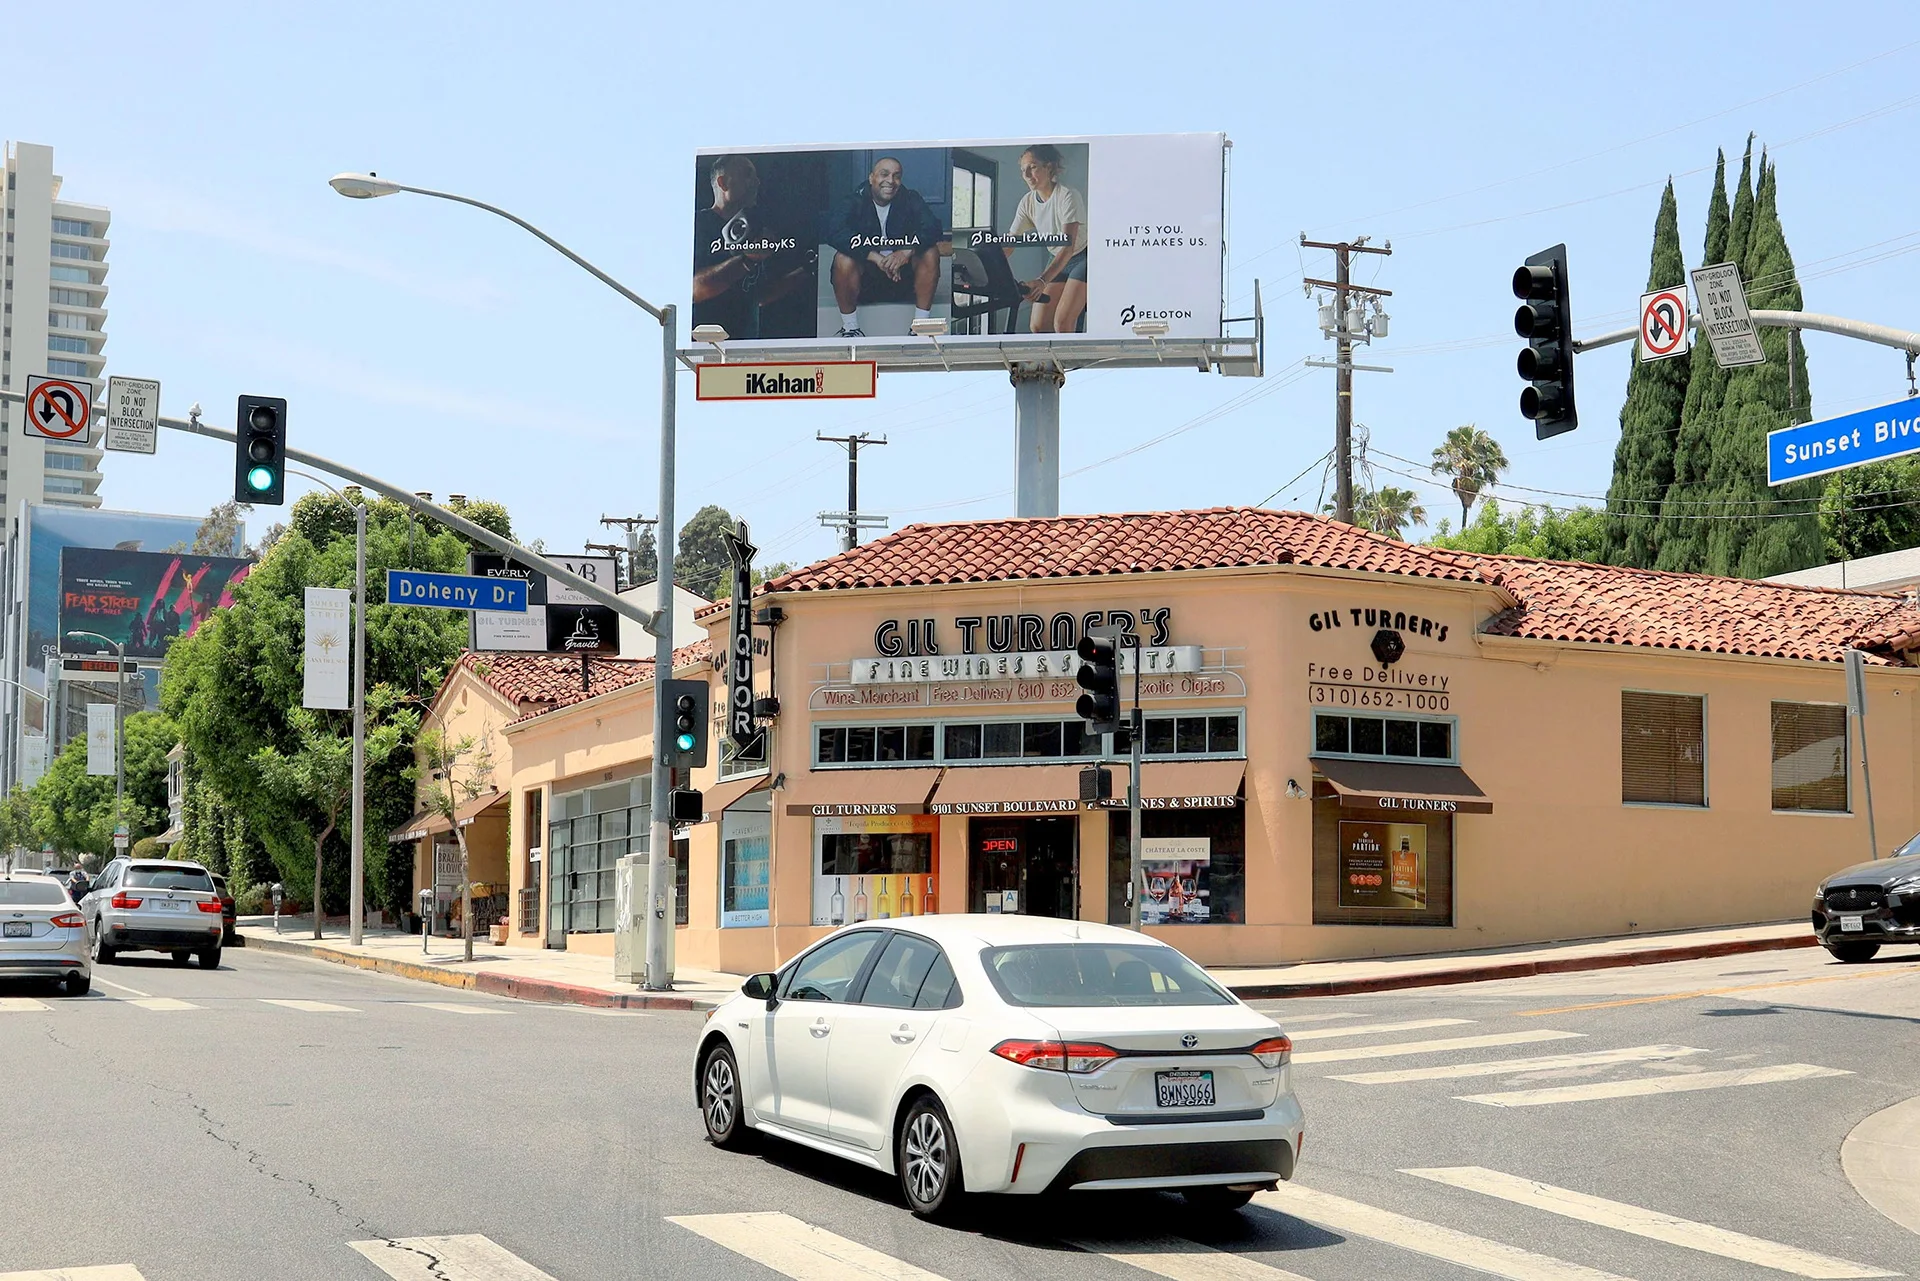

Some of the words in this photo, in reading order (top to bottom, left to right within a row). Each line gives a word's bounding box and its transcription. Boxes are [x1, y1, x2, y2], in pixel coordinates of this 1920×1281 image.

[1129, 225, 1151, 235] IT'S
[1156, 225, 1184, 235] YOU.
[862, 235, 920, 247] ACfromLA
[984, 231, 1069, 244] Berlin_It2WinIt
[1105, 238, 1136, 247] THAT
[1141, 237, 1184, 247] MAKES
[1189, 237, 1208, 247] US.
[724, 238, 796, 252] LondonBoyKS
[1694, 268, 1735, 283] ANTI-GRIDLOCK
[1709, 279, 1724, 289] ZONE
[1707, 292, 1718, 305] DO
[1719, 289, 1732, 303] NOT
[1138, 310, 1192, 320] PELOTON
[1713, 305, 1735, 320] BLOCK
[1708, 319, 1752, 336] INTERSECTION
[112, 380, 157, 391] ANTI-GRIDLOCK
[120, 395, 131, 405] DO
[134, 397, 146, 407] NOT
[122, 407, 143, 418] BLOCK
[110, 417, 154, 430] INTERSECTION
[1785, 427, 1861, 464] Sunset
[487, 569, 531, 578] EVERLY
[400, 579, 478, 606] Doheny
[493, 586, 516, 604] Dr
[65, 592, 96, 609] FEAR
[100, 596, 141, 610] STREET
[310, 600, 345, 608] SUNSET
[310, 611, 345, 619] STRIP
[1309, 609, 1342, 632] GIL
[1350, 608, 1449, 642] TURNER'S
[874, 618, 939, 657] GIL
[955, 607, 1171, 655] TURNER'S
[736, 582, 752, 734] LIQUOR
[81, 661, 118, 672] NETFLIX
[870, 659, 929, 679] FINE
[941, 656, 1023, 677] WINES
[1036, 655, 1048, 673] &
[1308, 662, 1353, 680] Free
[1363, 666, 1449, 690] Delivery
[823, 690, 855, 704] Wine
[860, 687, 920, 704] Merchant
[933, 687, 959, 701] Free
[963, 685, 1013, 702] Delivery
[1017, 682, 1045, 700] (310)
[1181, 678, 1225, 696] Cigars
[1308, 685, 1449, 711] (310)652-1000
[932, 804, 953, 814] 9101
[956, 801, 1000, 813] SUNSET
[1003, 800, 1077, 813] BOULEVARD
[1169, 797, 1180, 808] &
[1183, 795, 1234, 807] SPIRITS
[1378, 797, 1399, 809] GIL
[1401, 798, 1457, 811] TURNER'S
[811, 805, 834, 815] GIL
[835, 804, 897, 815] TURNER'S
[983, 840, 1015, 851] OPEN
[1352, 843, 1379, 851] PARTIDA
[1005, 892, 1014, 901] A
